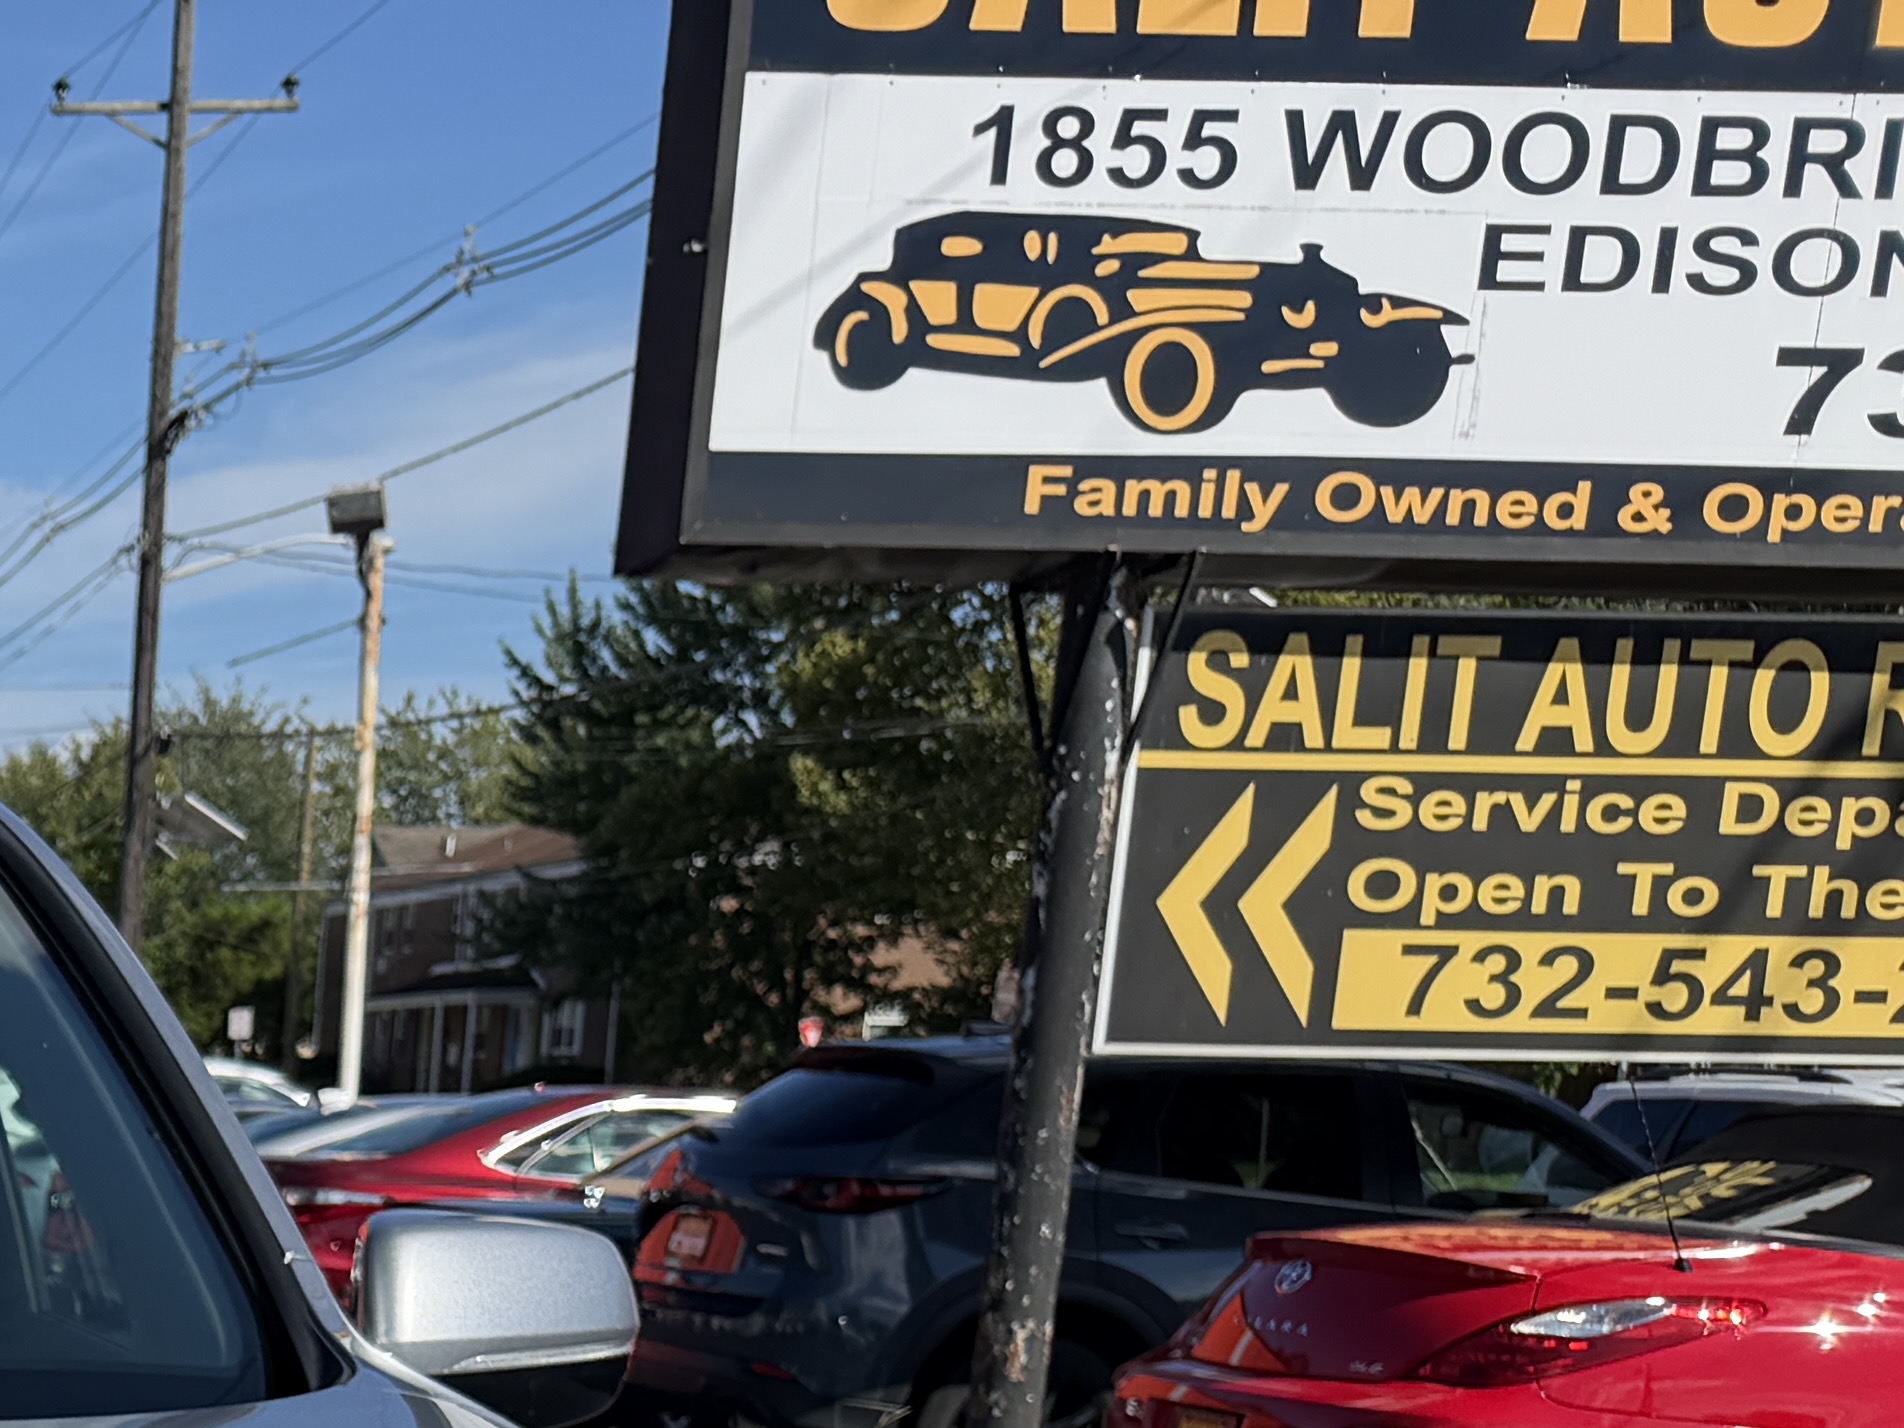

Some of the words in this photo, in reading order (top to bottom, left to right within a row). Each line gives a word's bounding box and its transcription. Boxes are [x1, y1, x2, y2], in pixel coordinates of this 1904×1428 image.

[972, 104, 1240, 190] 1855
[1284, 108, 1904, 200] WOODBRI
[1023, 463, 1290, 532] Family
[1314, 471, 1592, 531] Owned
[1616, 481, 1673, 534] &
[1702, 481, 1904, 543] Oper
[1178, 629, 1502, 751] SALIT
[1514, 637, 1830, 757] AUTO
[1355, 775, 1687, 835] Service
[1718, 781, 1904, 850] Dep
[1346, 857, 1582, 926] Open
[1616, 862, 1719, 918] To
[1752, 865, 1904, 921] The
[1400, 944, 1904, 1025] 732-543-
